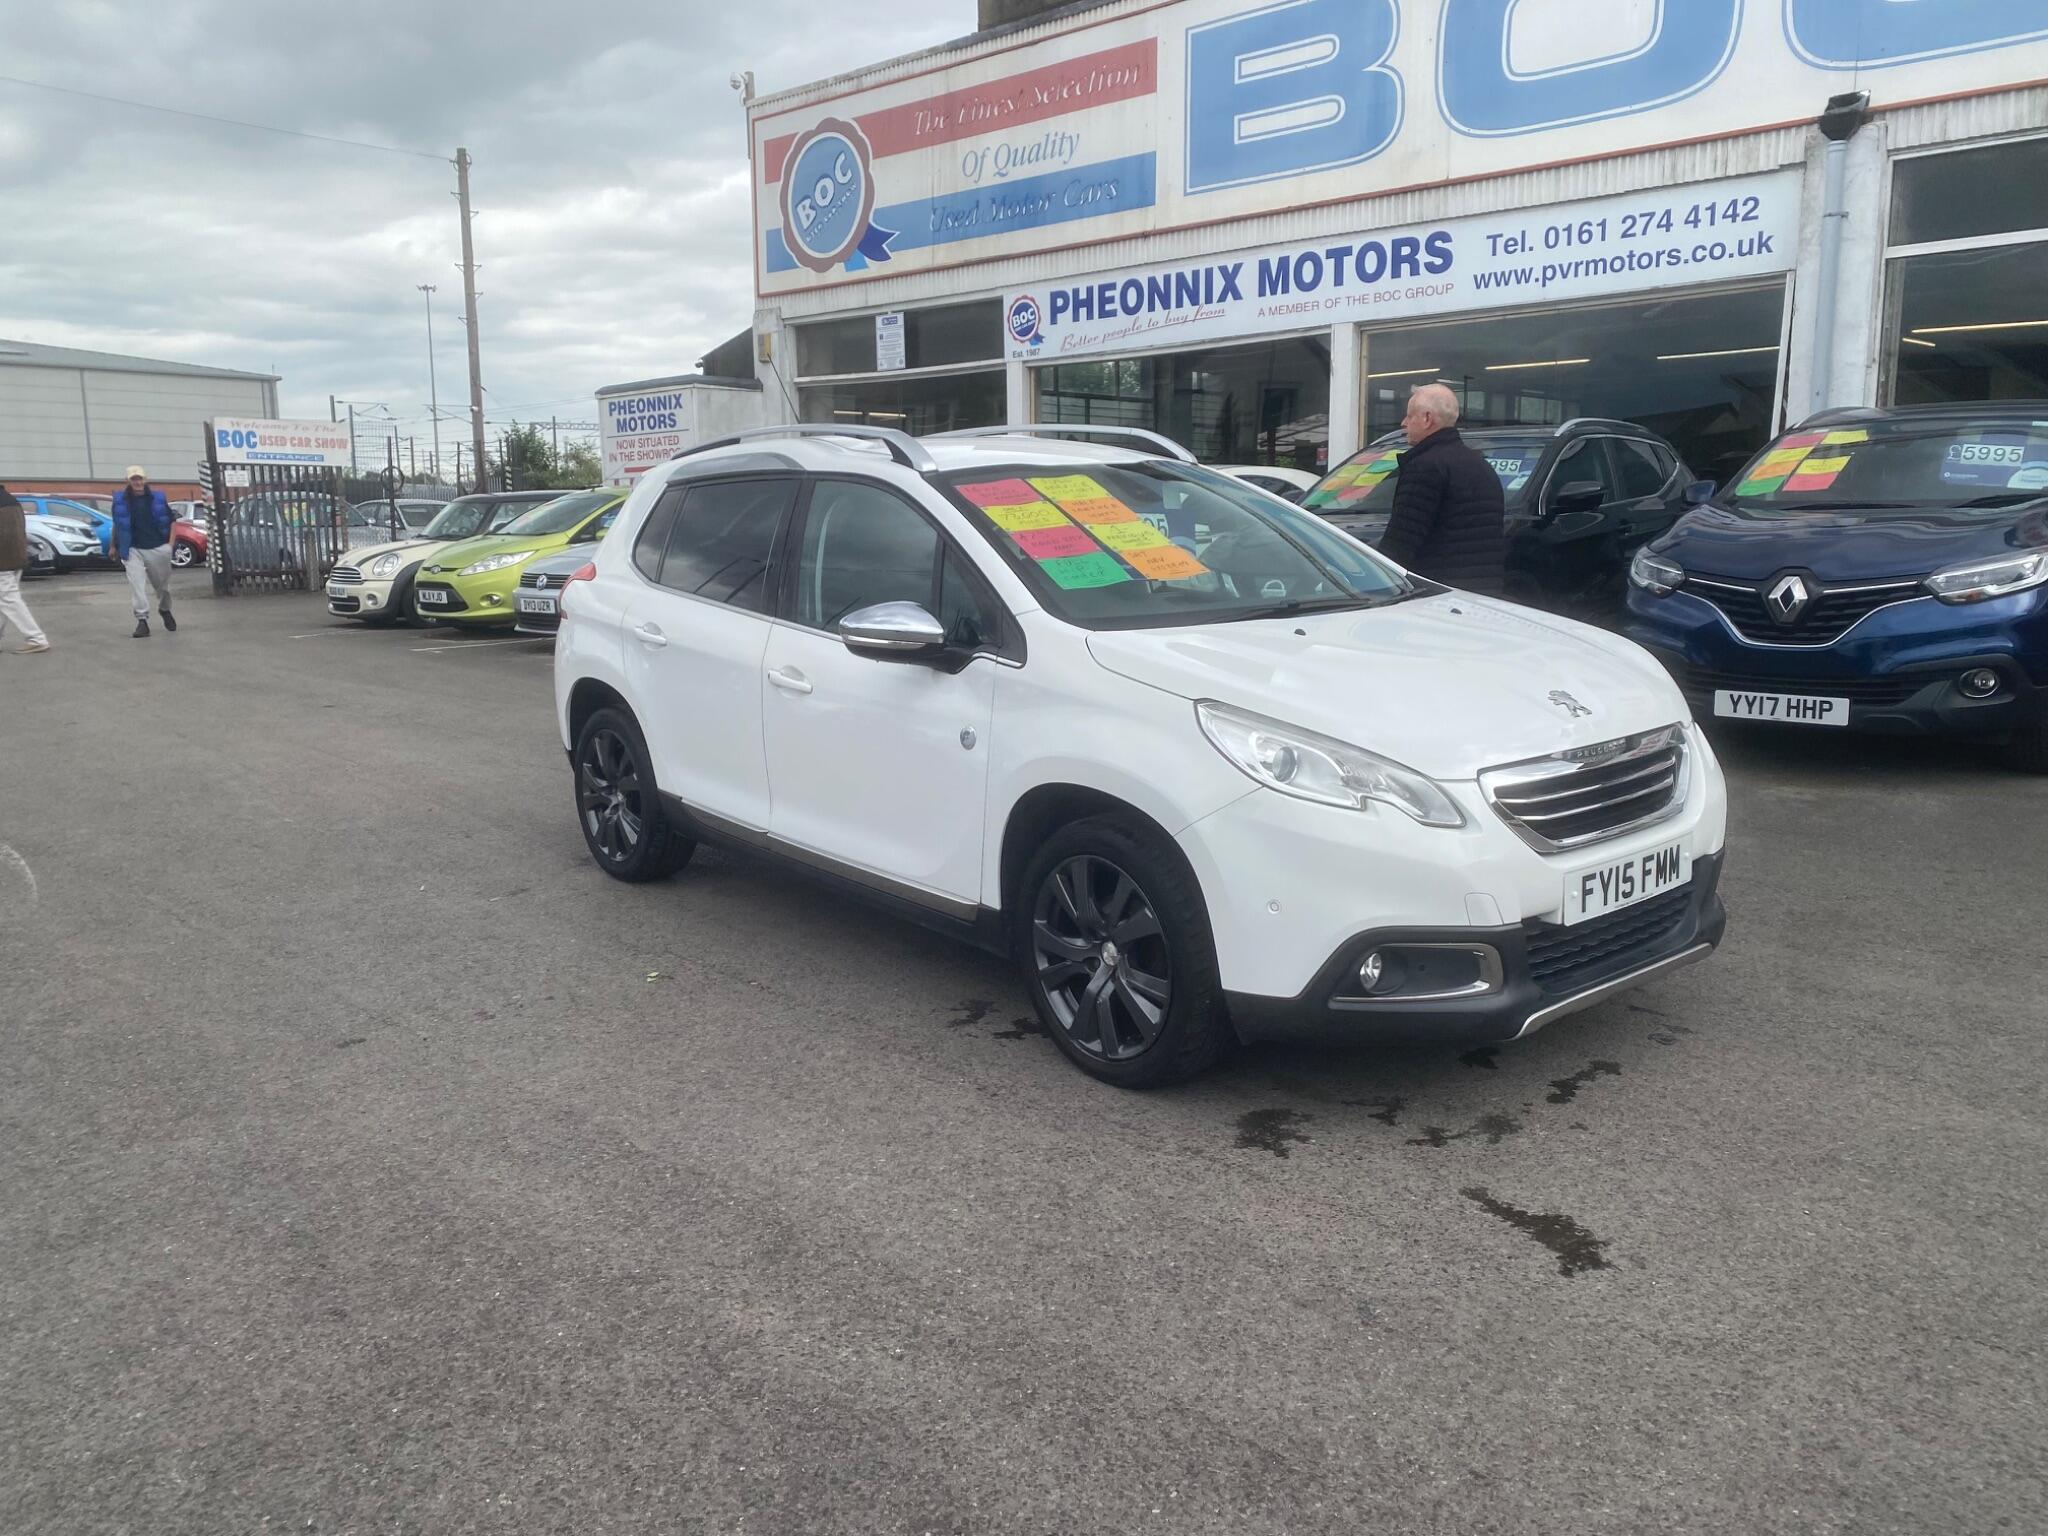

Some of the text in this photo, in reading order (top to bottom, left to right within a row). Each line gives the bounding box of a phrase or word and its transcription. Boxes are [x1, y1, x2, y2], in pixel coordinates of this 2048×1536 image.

[1030, 64, 1140, 108] Selection
[962, 131, 1081, 184] Of Quality
[796, 151, 853, 230] BOC
[929, 200, 980, 233] Used
[1063, 177, 1121, 210] Cars
[1486, 195, 1760, 257] Tel. 0161 274 4142
[1473, 230, 1775, 291] www.pvrmotors.co.uk
[1049, 230, 1453, 326] PHEONNIX MOTORS
[1257, 282, 1455, 318] A MEMBER OF THE BOC GROUP
[1012, 307, 1036, 328] BOC
[1060, 303, 1226, 352] Better people to buy from
[1026, 348, 1040, 357] 1987
[608, 393, 683, 417] PHEONNIX
[616, 412, 677, 433] MOTORS
[216, 429, 349, 450] BOC USED CAR SHOW
[608, 447, 681, 463] IN THE SHOWRO
[616, 435, 680, 450] NOW SITUATED
[1947, 444, 2023, 463] £5995
[247, 452, 323, 462] ENTRANCE
[1729, 693, 1834, 720] YY17 HHP
[1582, 844, 1681, 913] FY15 FMM
